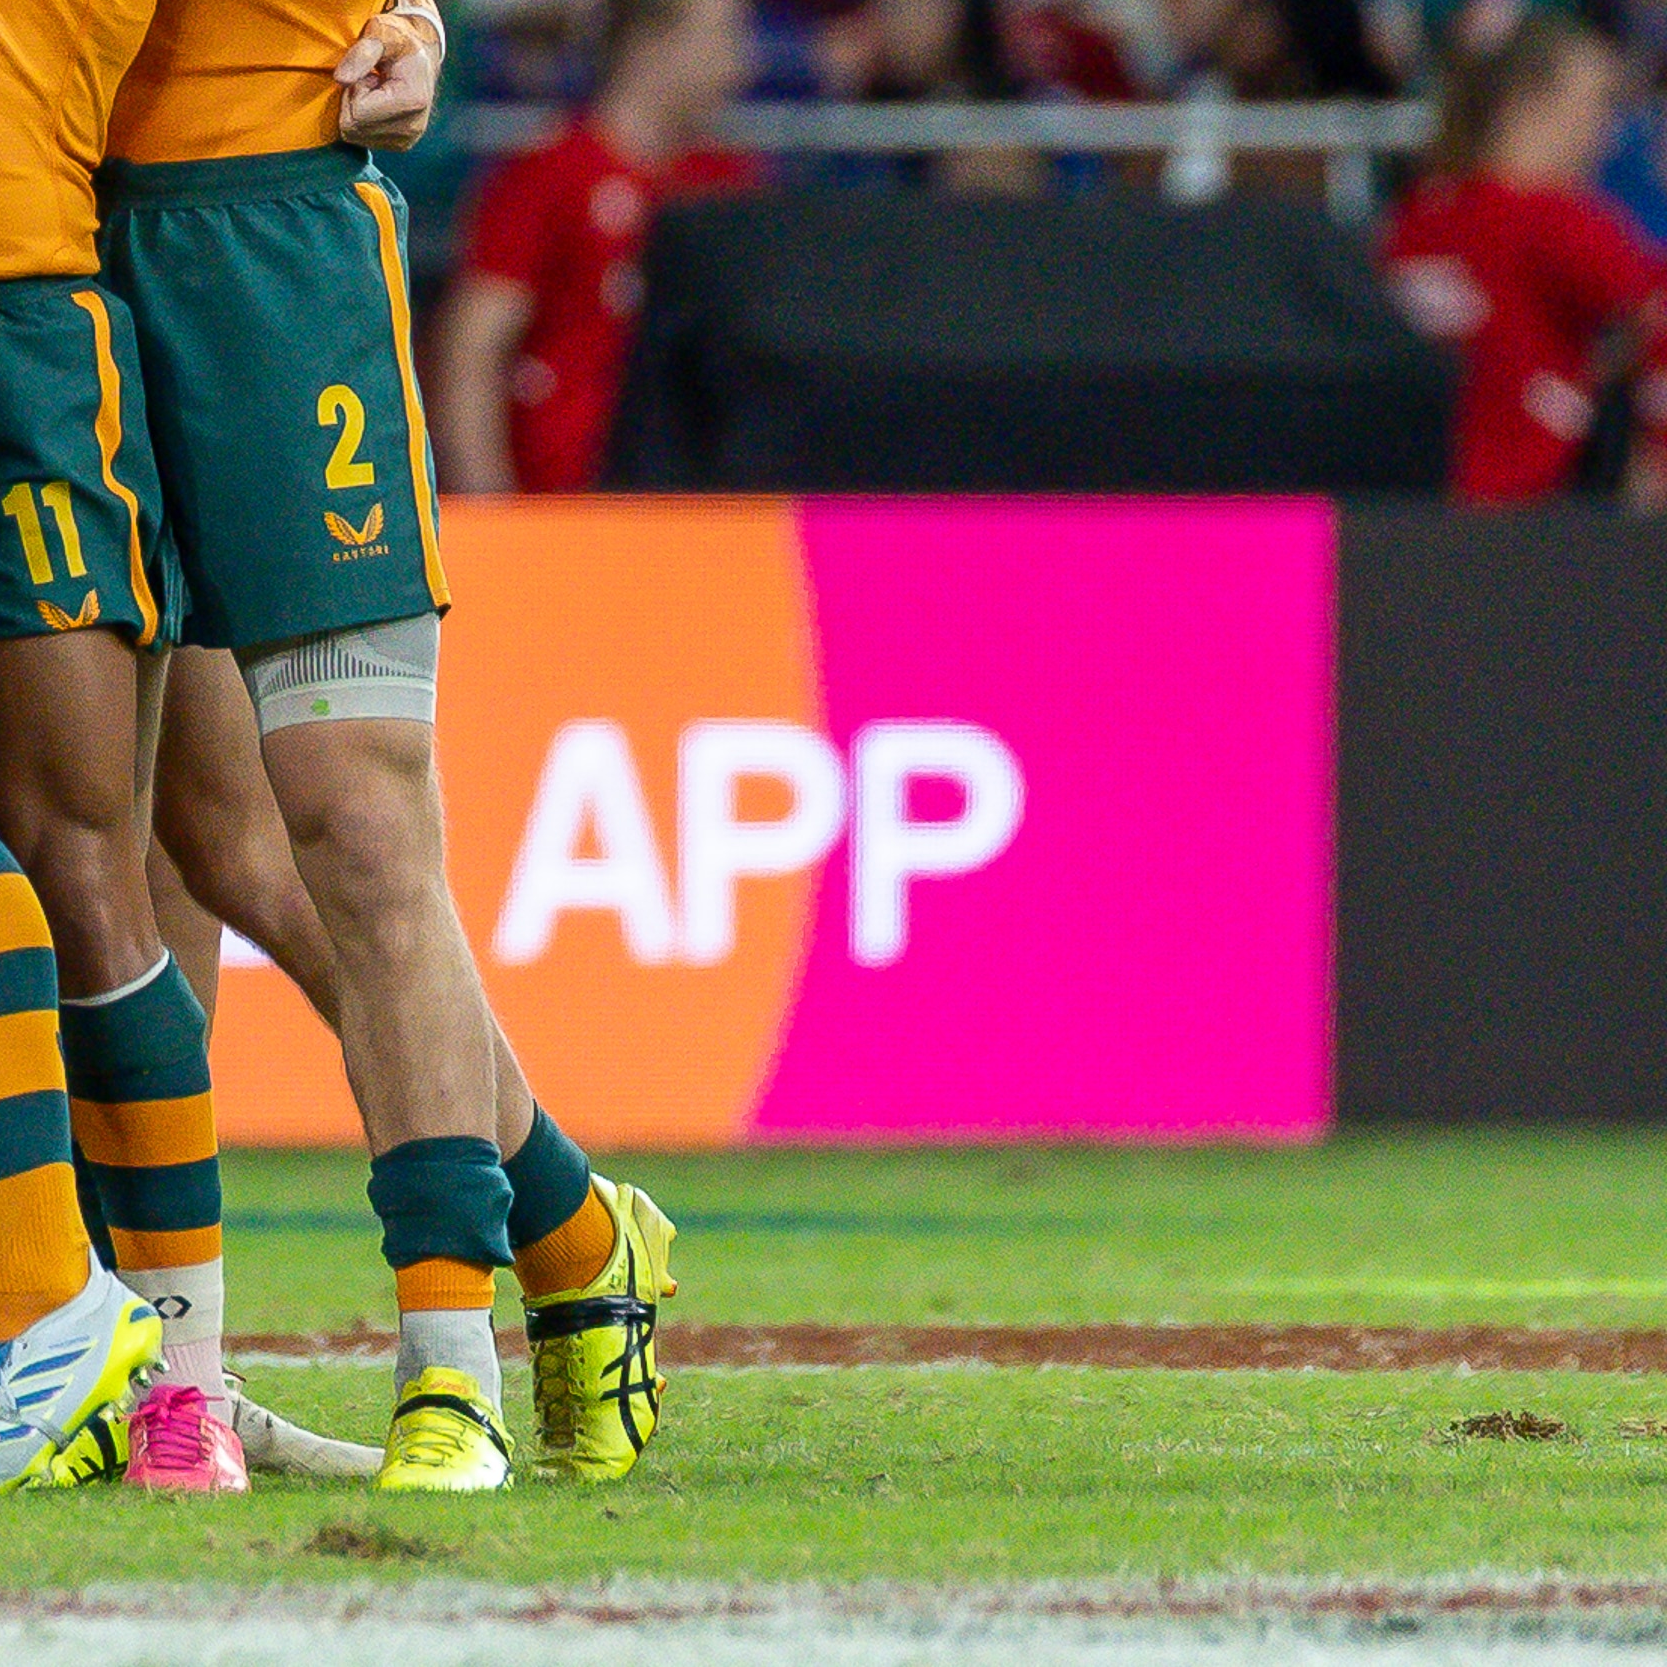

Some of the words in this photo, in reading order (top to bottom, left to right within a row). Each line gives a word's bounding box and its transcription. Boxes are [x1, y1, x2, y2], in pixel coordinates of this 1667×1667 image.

[318, 384, 375, 489] 2
[1, 482, 87, 585] 11
[493, 717, 1027, 969] APP
